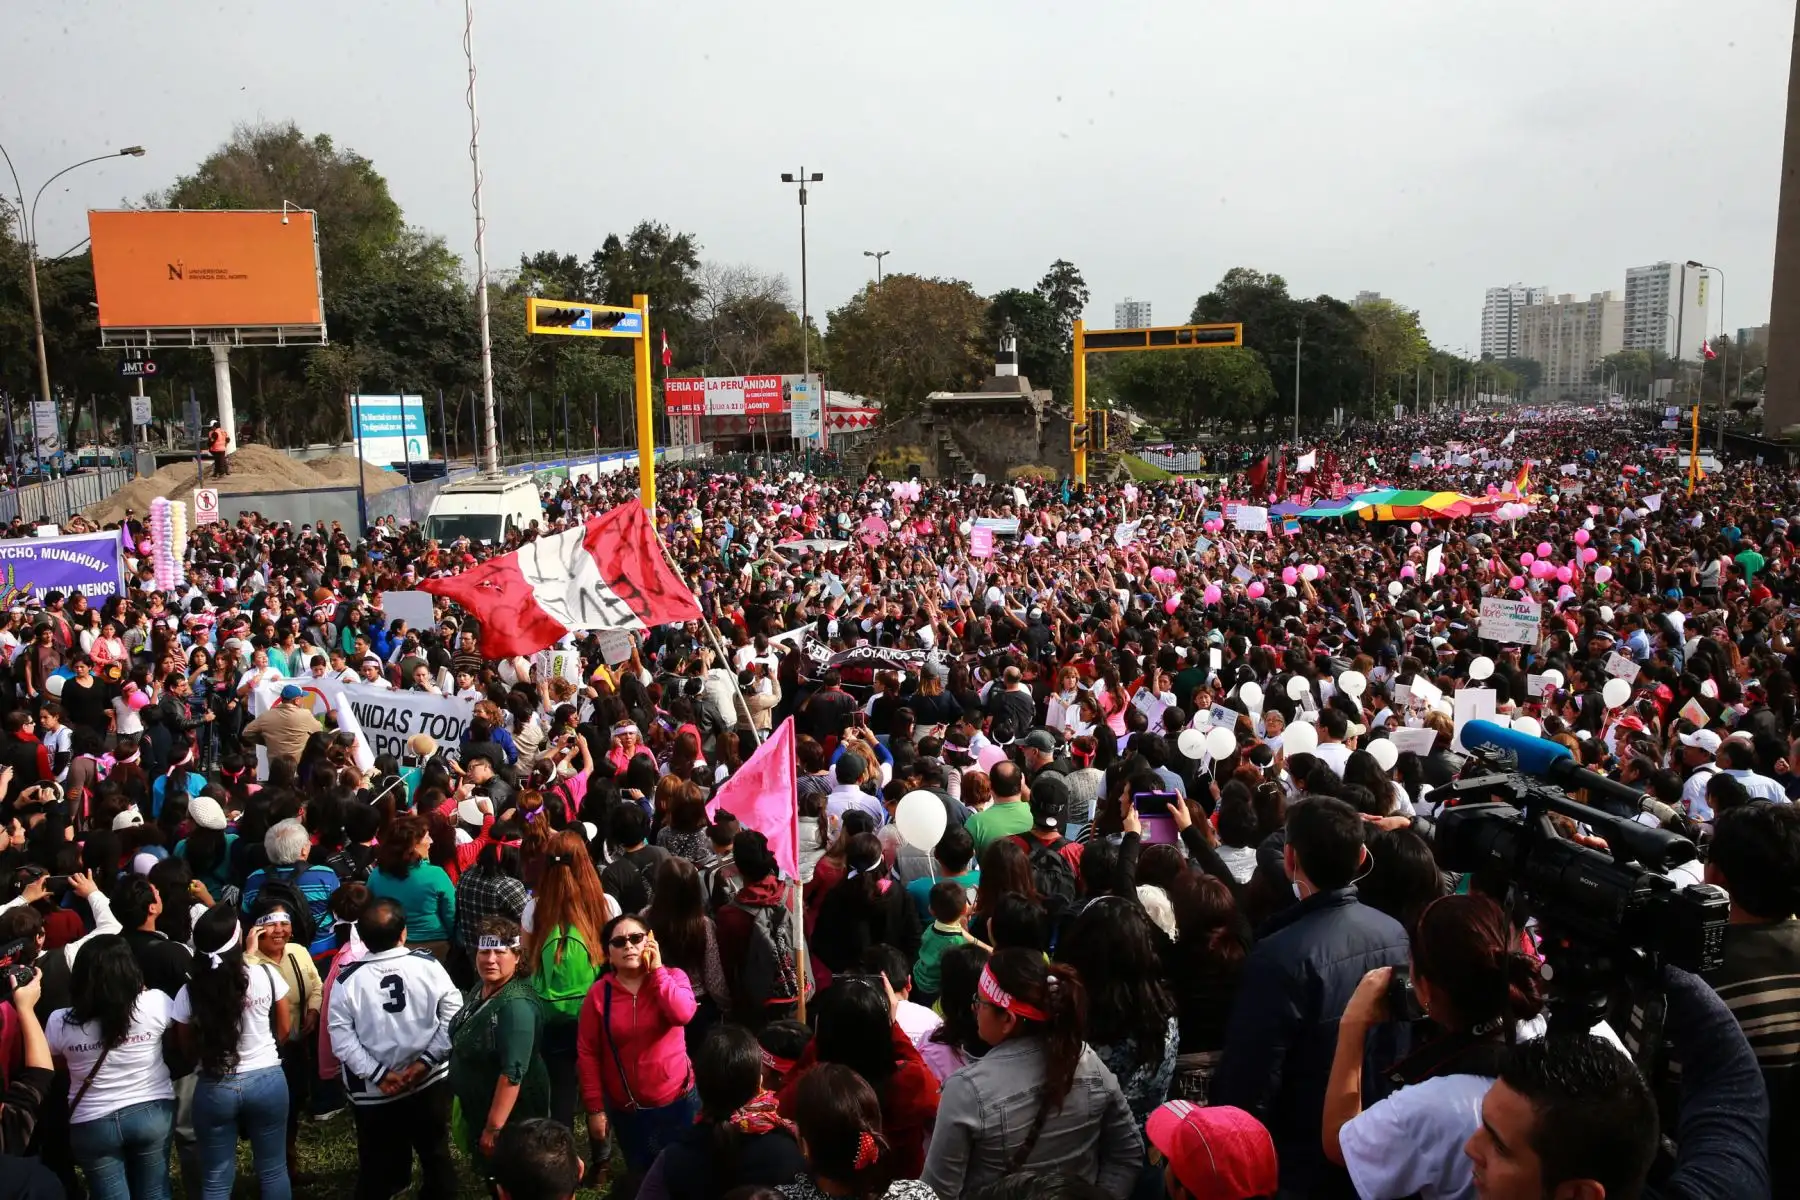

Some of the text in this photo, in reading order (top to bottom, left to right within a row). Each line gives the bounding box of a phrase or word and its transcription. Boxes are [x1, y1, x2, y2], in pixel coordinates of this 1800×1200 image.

[122, 362, 144, 372] JMT
[666, 379, 777, 391] FERIA DE LA PERUANIDAD
[747, 402, 770, 410] AGOSTO
[41, 547, 109, 573] MUNAHUAY
[77, 581, 116, 598] MENOS
[1514, 604, 1530, 614] VIDA
[846, 647, 911, 661] APOYAMOS
[1580, 877, 1599, 888] SONY
[380, 974, 406, 1013] 3
